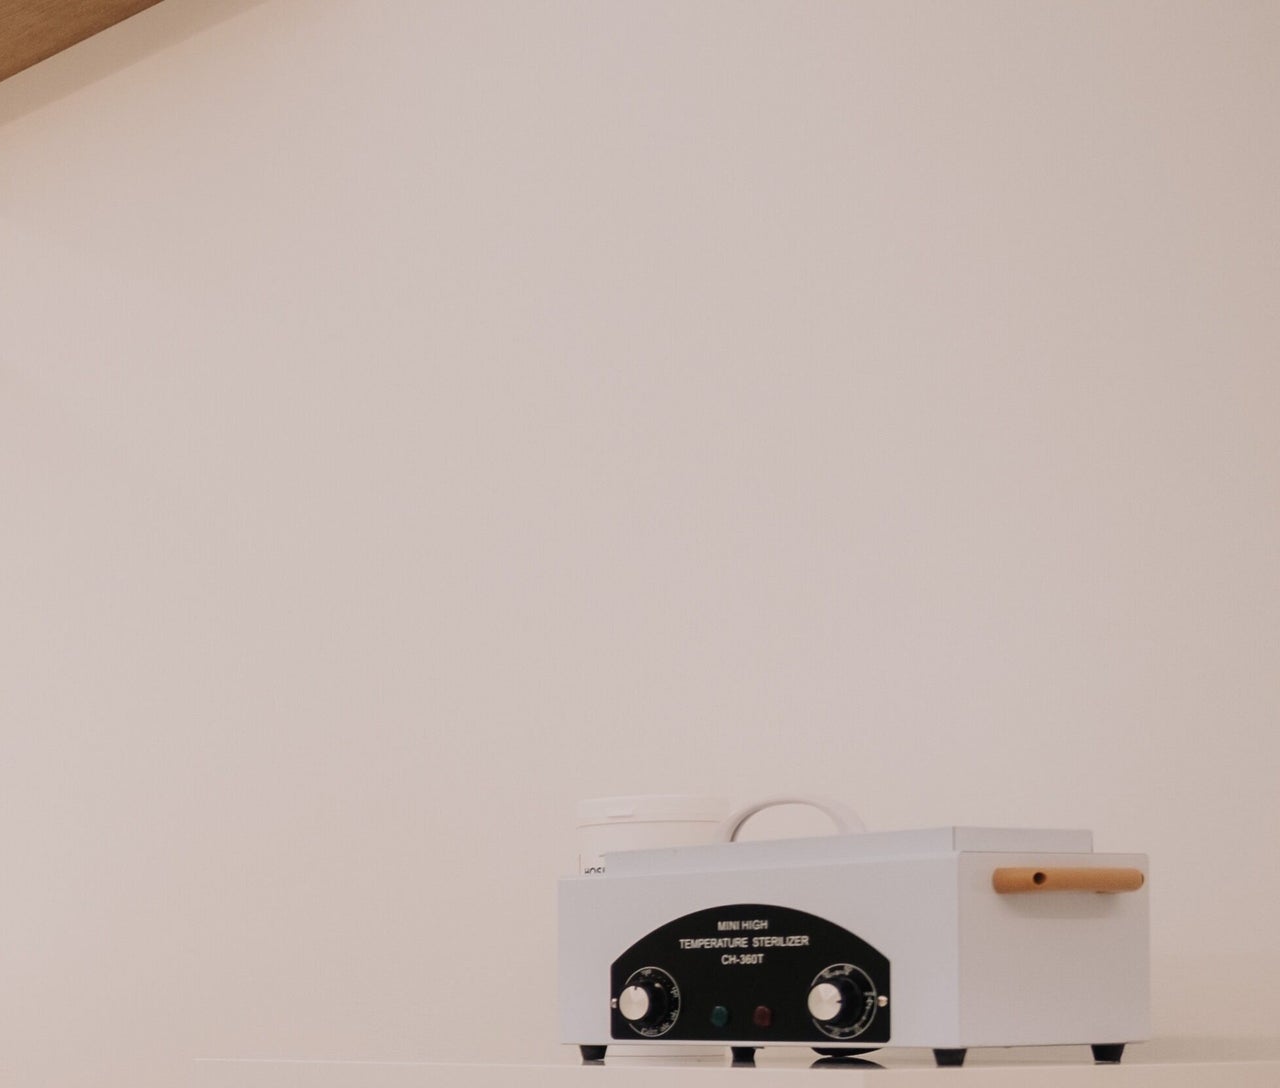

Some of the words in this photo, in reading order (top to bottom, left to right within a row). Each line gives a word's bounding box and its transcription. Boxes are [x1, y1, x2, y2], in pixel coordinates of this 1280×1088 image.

[718, 921, 741, 934] MINI
[742, 919, 768, 933] HIGH
[679, 936, 749, 951] TEMPERATURE
[753, 933, 809, 950] STERILIZER
[721, 952, 764, 967] CH-360T
